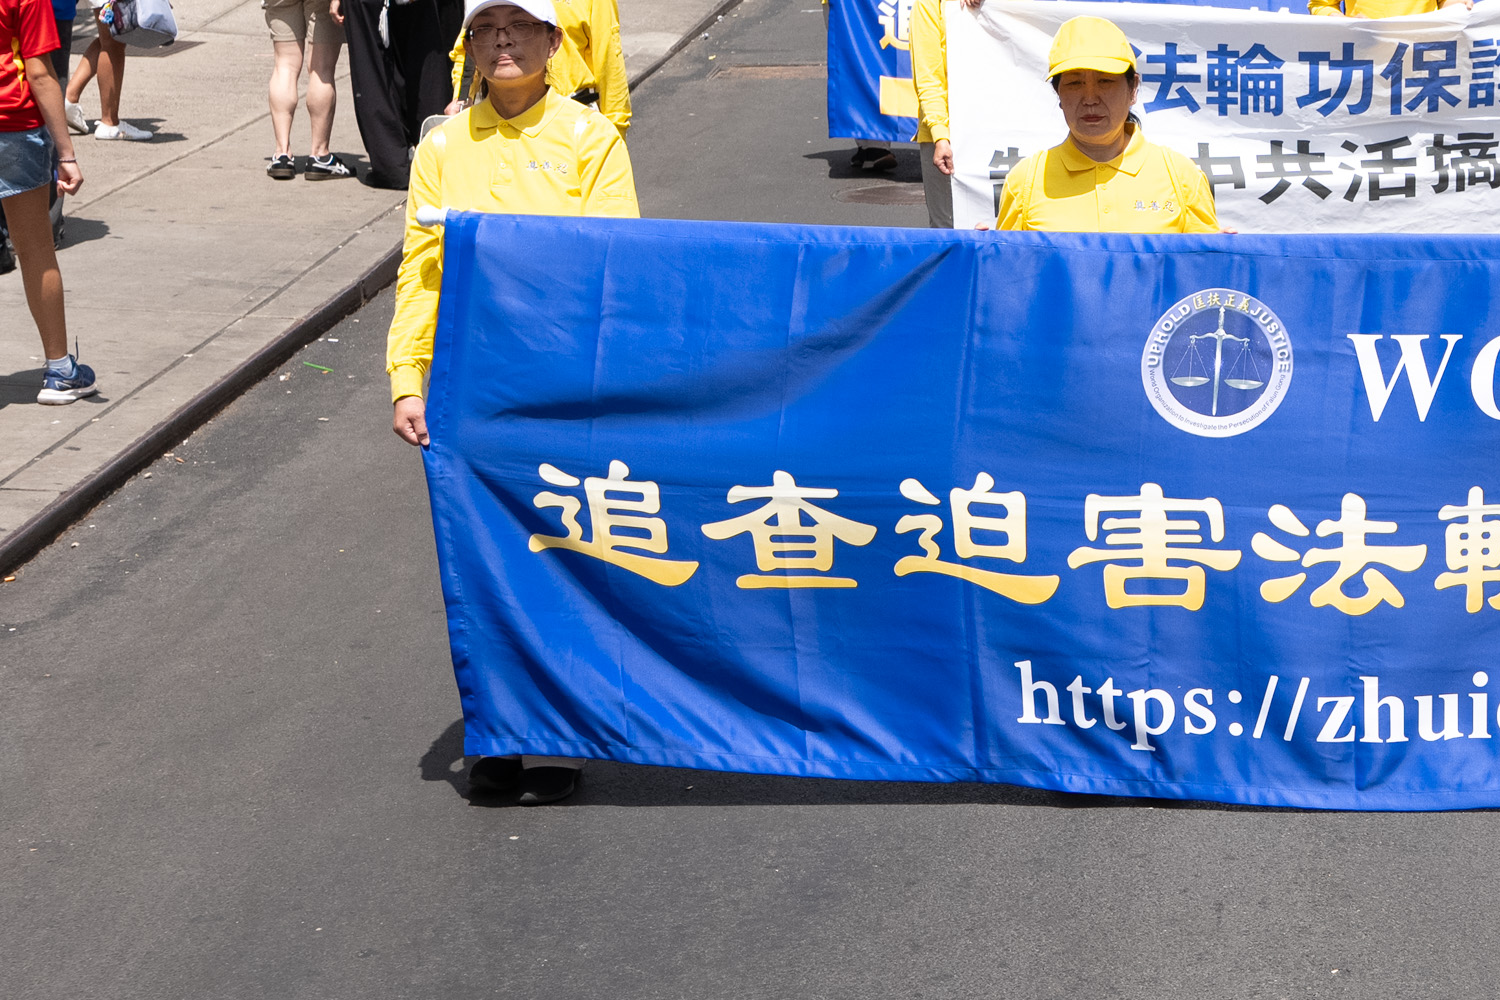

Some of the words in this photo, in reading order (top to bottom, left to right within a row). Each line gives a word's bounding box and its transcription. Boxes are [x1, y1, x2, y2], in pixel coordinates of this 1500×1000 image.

[1147, 304, 1191, 368] UPHOLD
[1250, 306, 1291, 373] JUSTICE
[1228, 410, 1263, 429] Persecution
